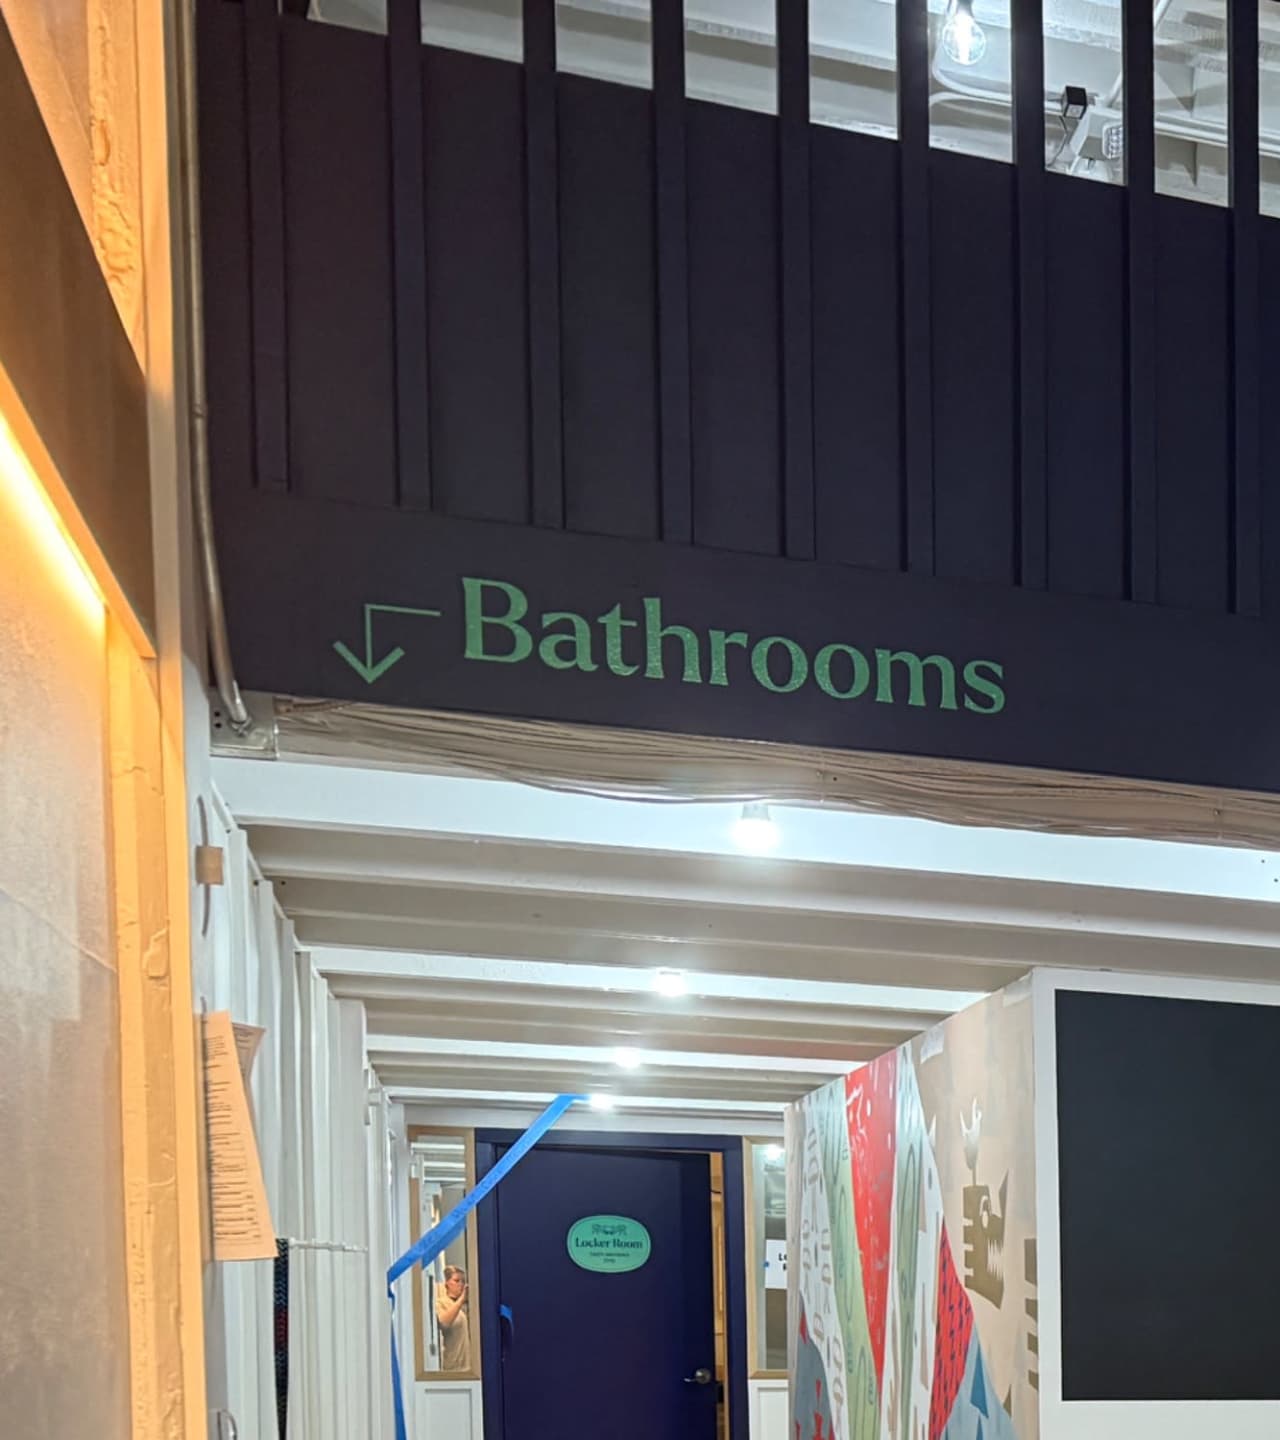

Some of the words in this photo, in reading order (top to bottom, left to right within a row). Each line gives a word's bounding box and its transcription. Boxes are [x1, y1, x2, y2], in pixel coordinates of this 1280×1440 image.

[462, 577, 1006, 716] Bathrooms
[575, 1236, 610, 1249] Locker
[612, 1238, 643, 1249] Room
